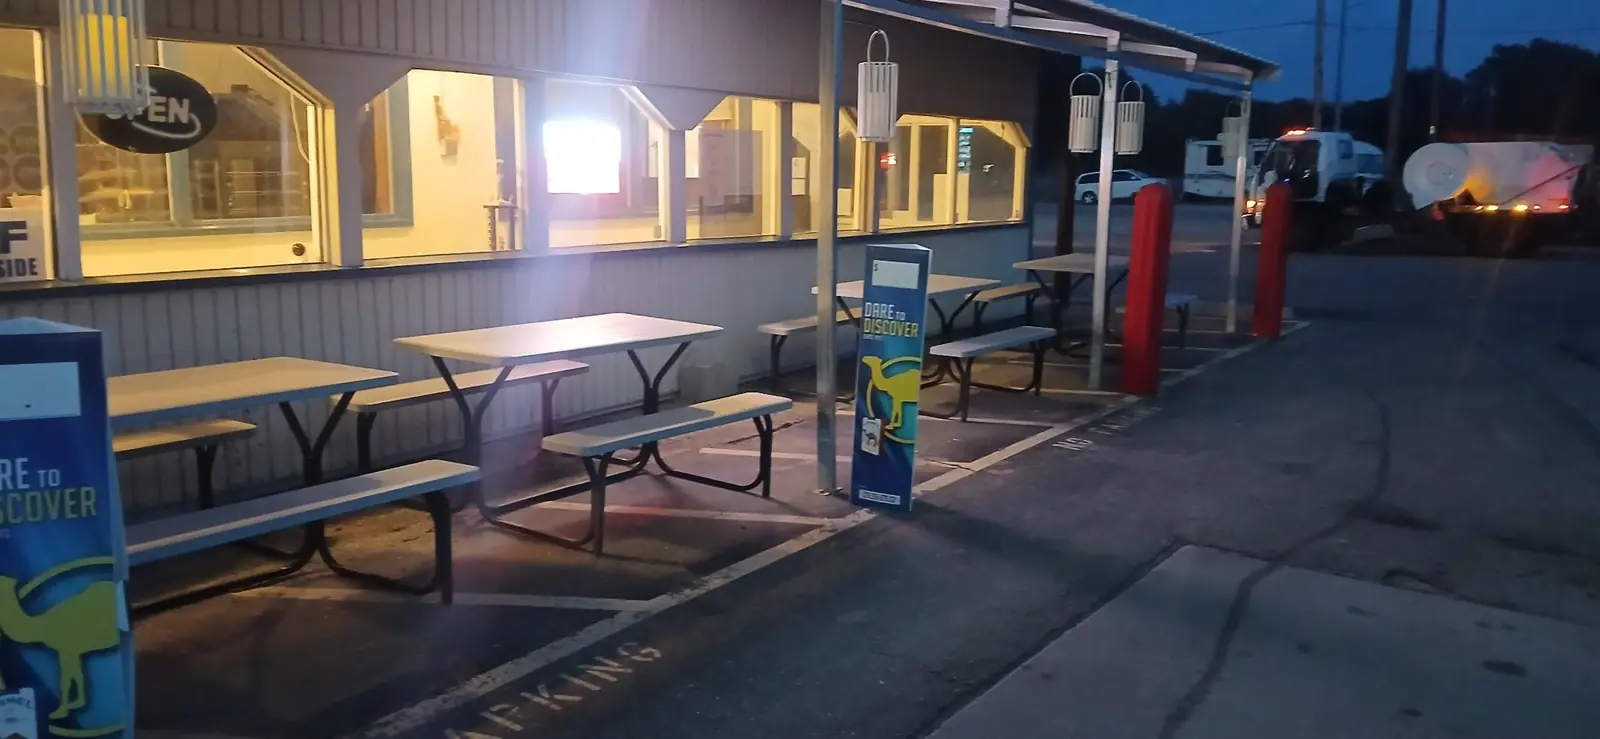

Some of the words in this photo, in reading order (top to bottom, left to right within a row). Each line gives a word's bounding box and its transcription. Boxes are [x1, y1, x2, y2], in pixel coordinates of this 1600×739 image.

[864, 302, 894, 320] DARE
[896, 311, 906, 320] TO
[863, 317, 919, 338] DISCOVER
[37, 469, 60, 488] TO
[0, 486, 97, 525] COVER
